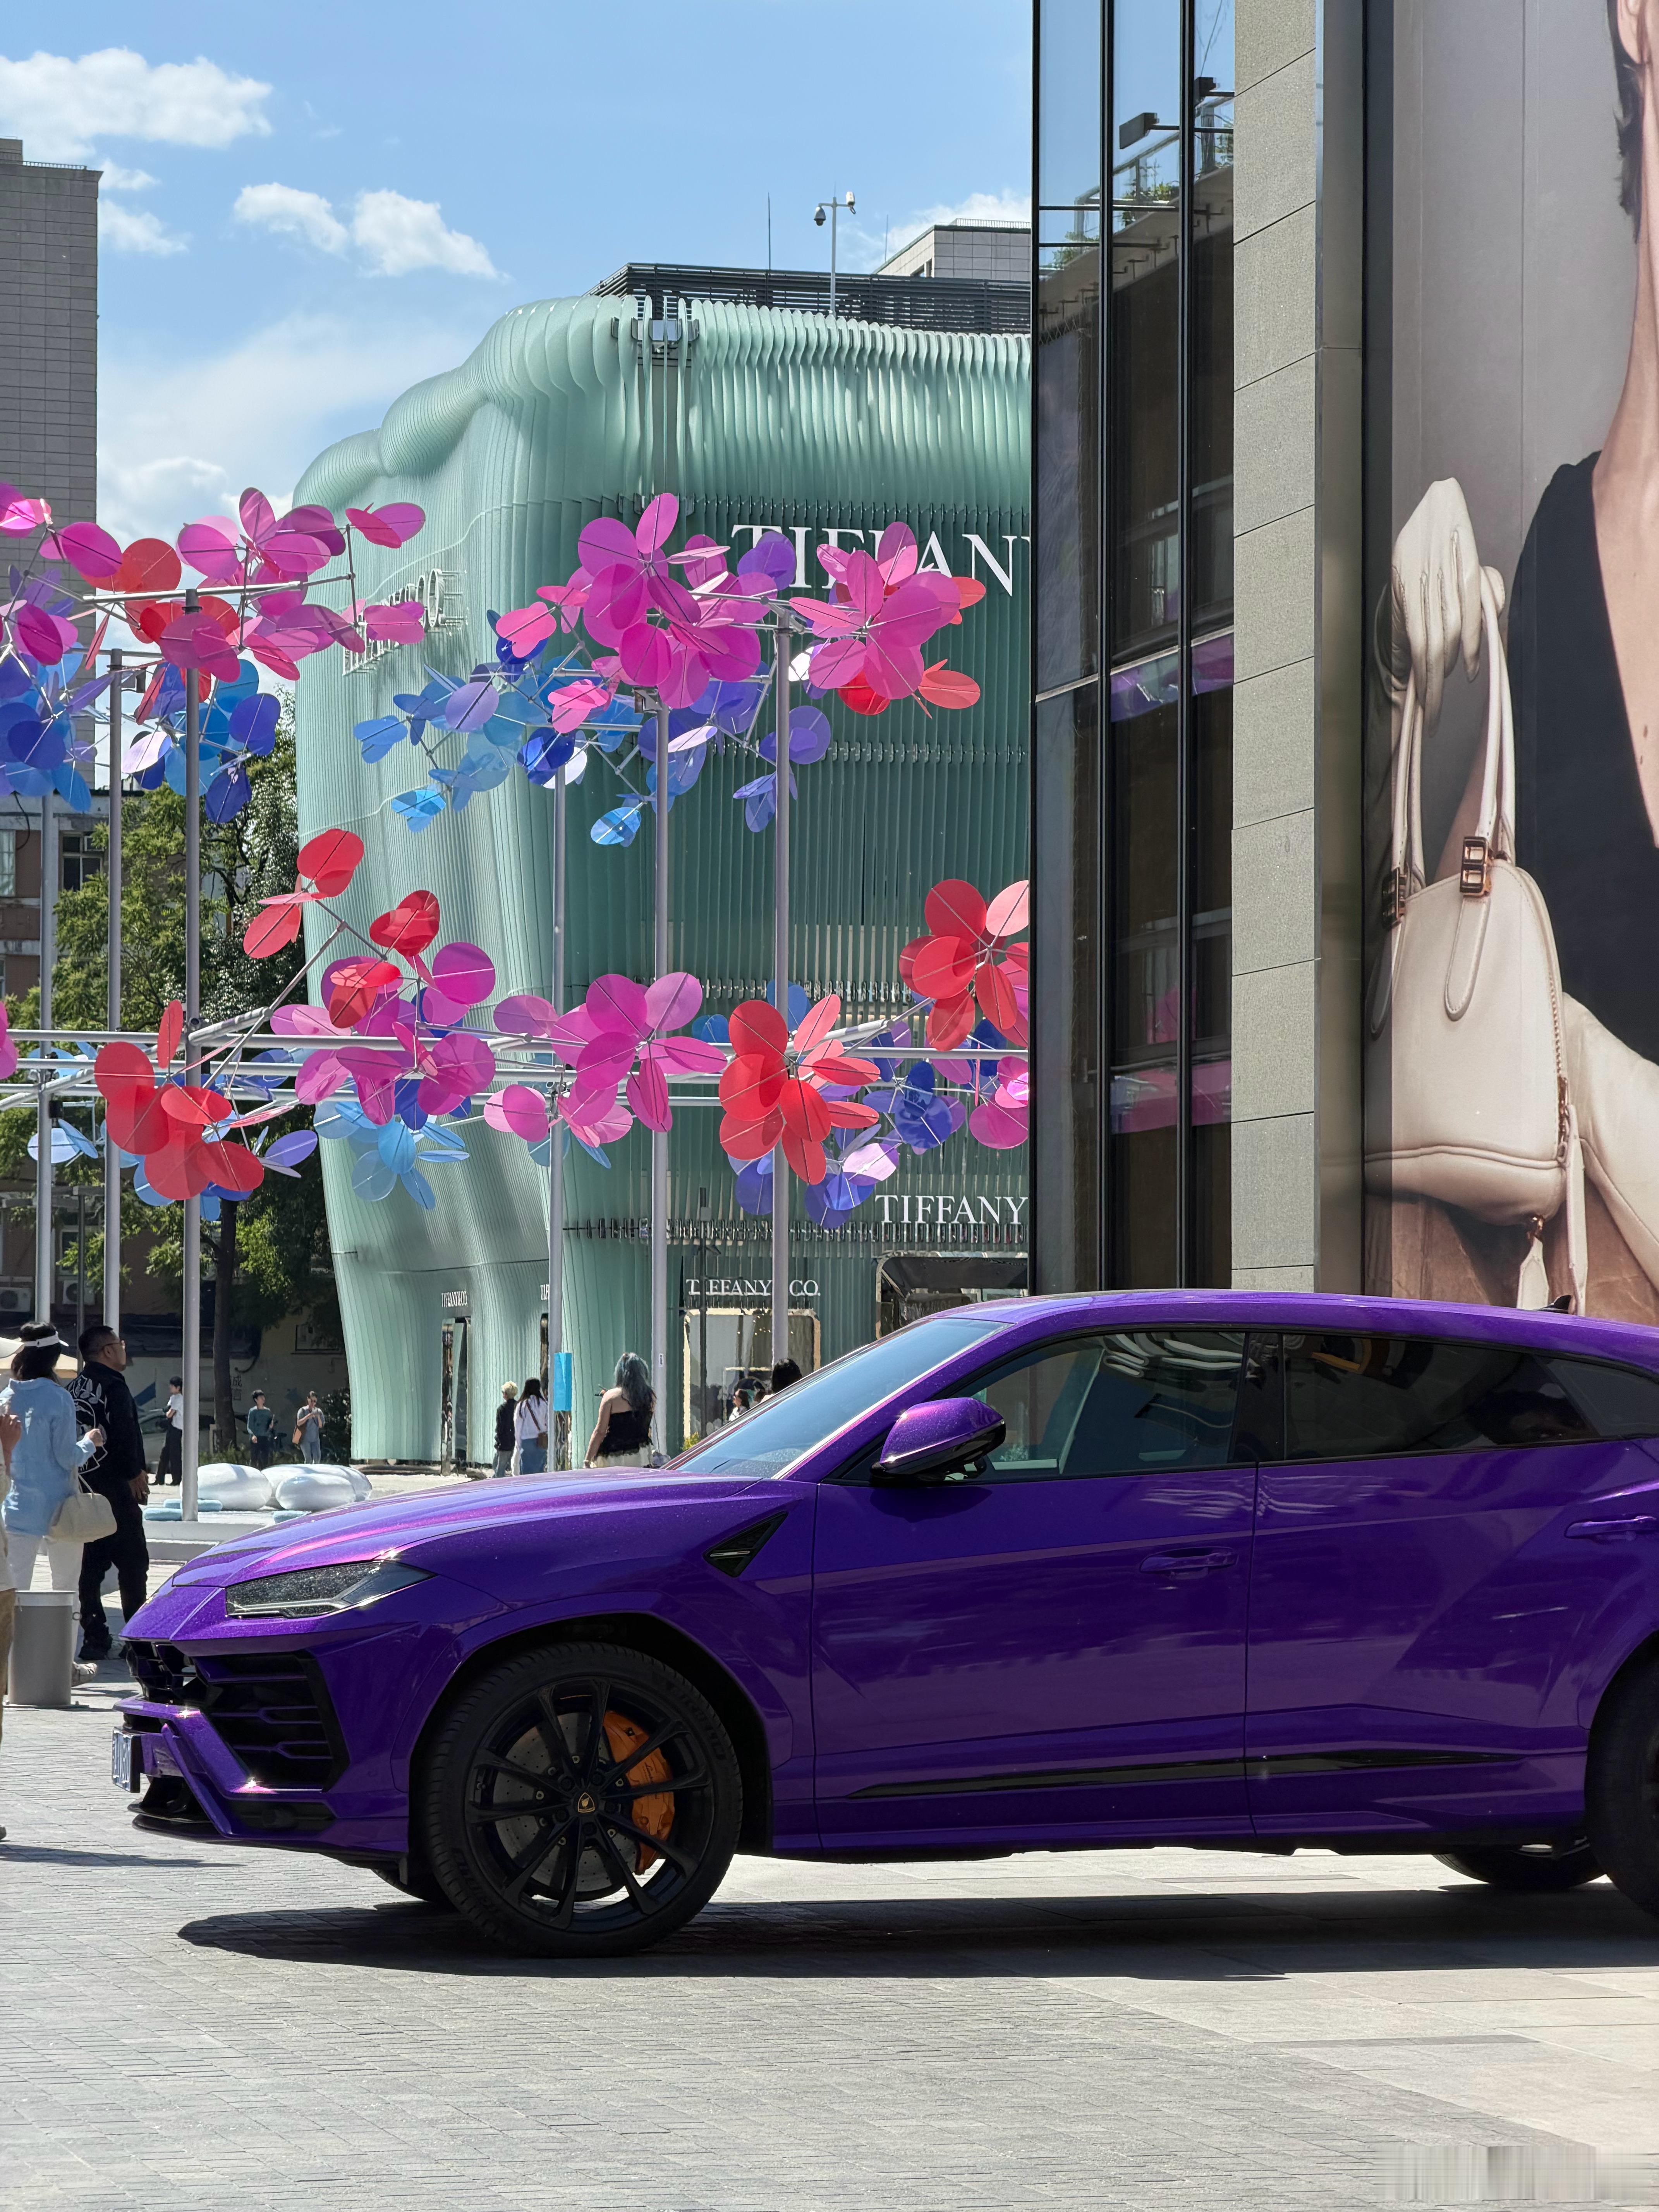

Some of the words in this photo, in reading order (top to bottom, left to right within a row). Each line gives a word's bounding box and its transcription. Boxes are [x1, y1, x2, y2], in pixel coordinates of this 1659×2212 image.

[874, 1195, 1029, 1224] TIFFANY
[685, 1279, 772, 1295] TFFANY
[789, 1279, 821, 1297] CO.
